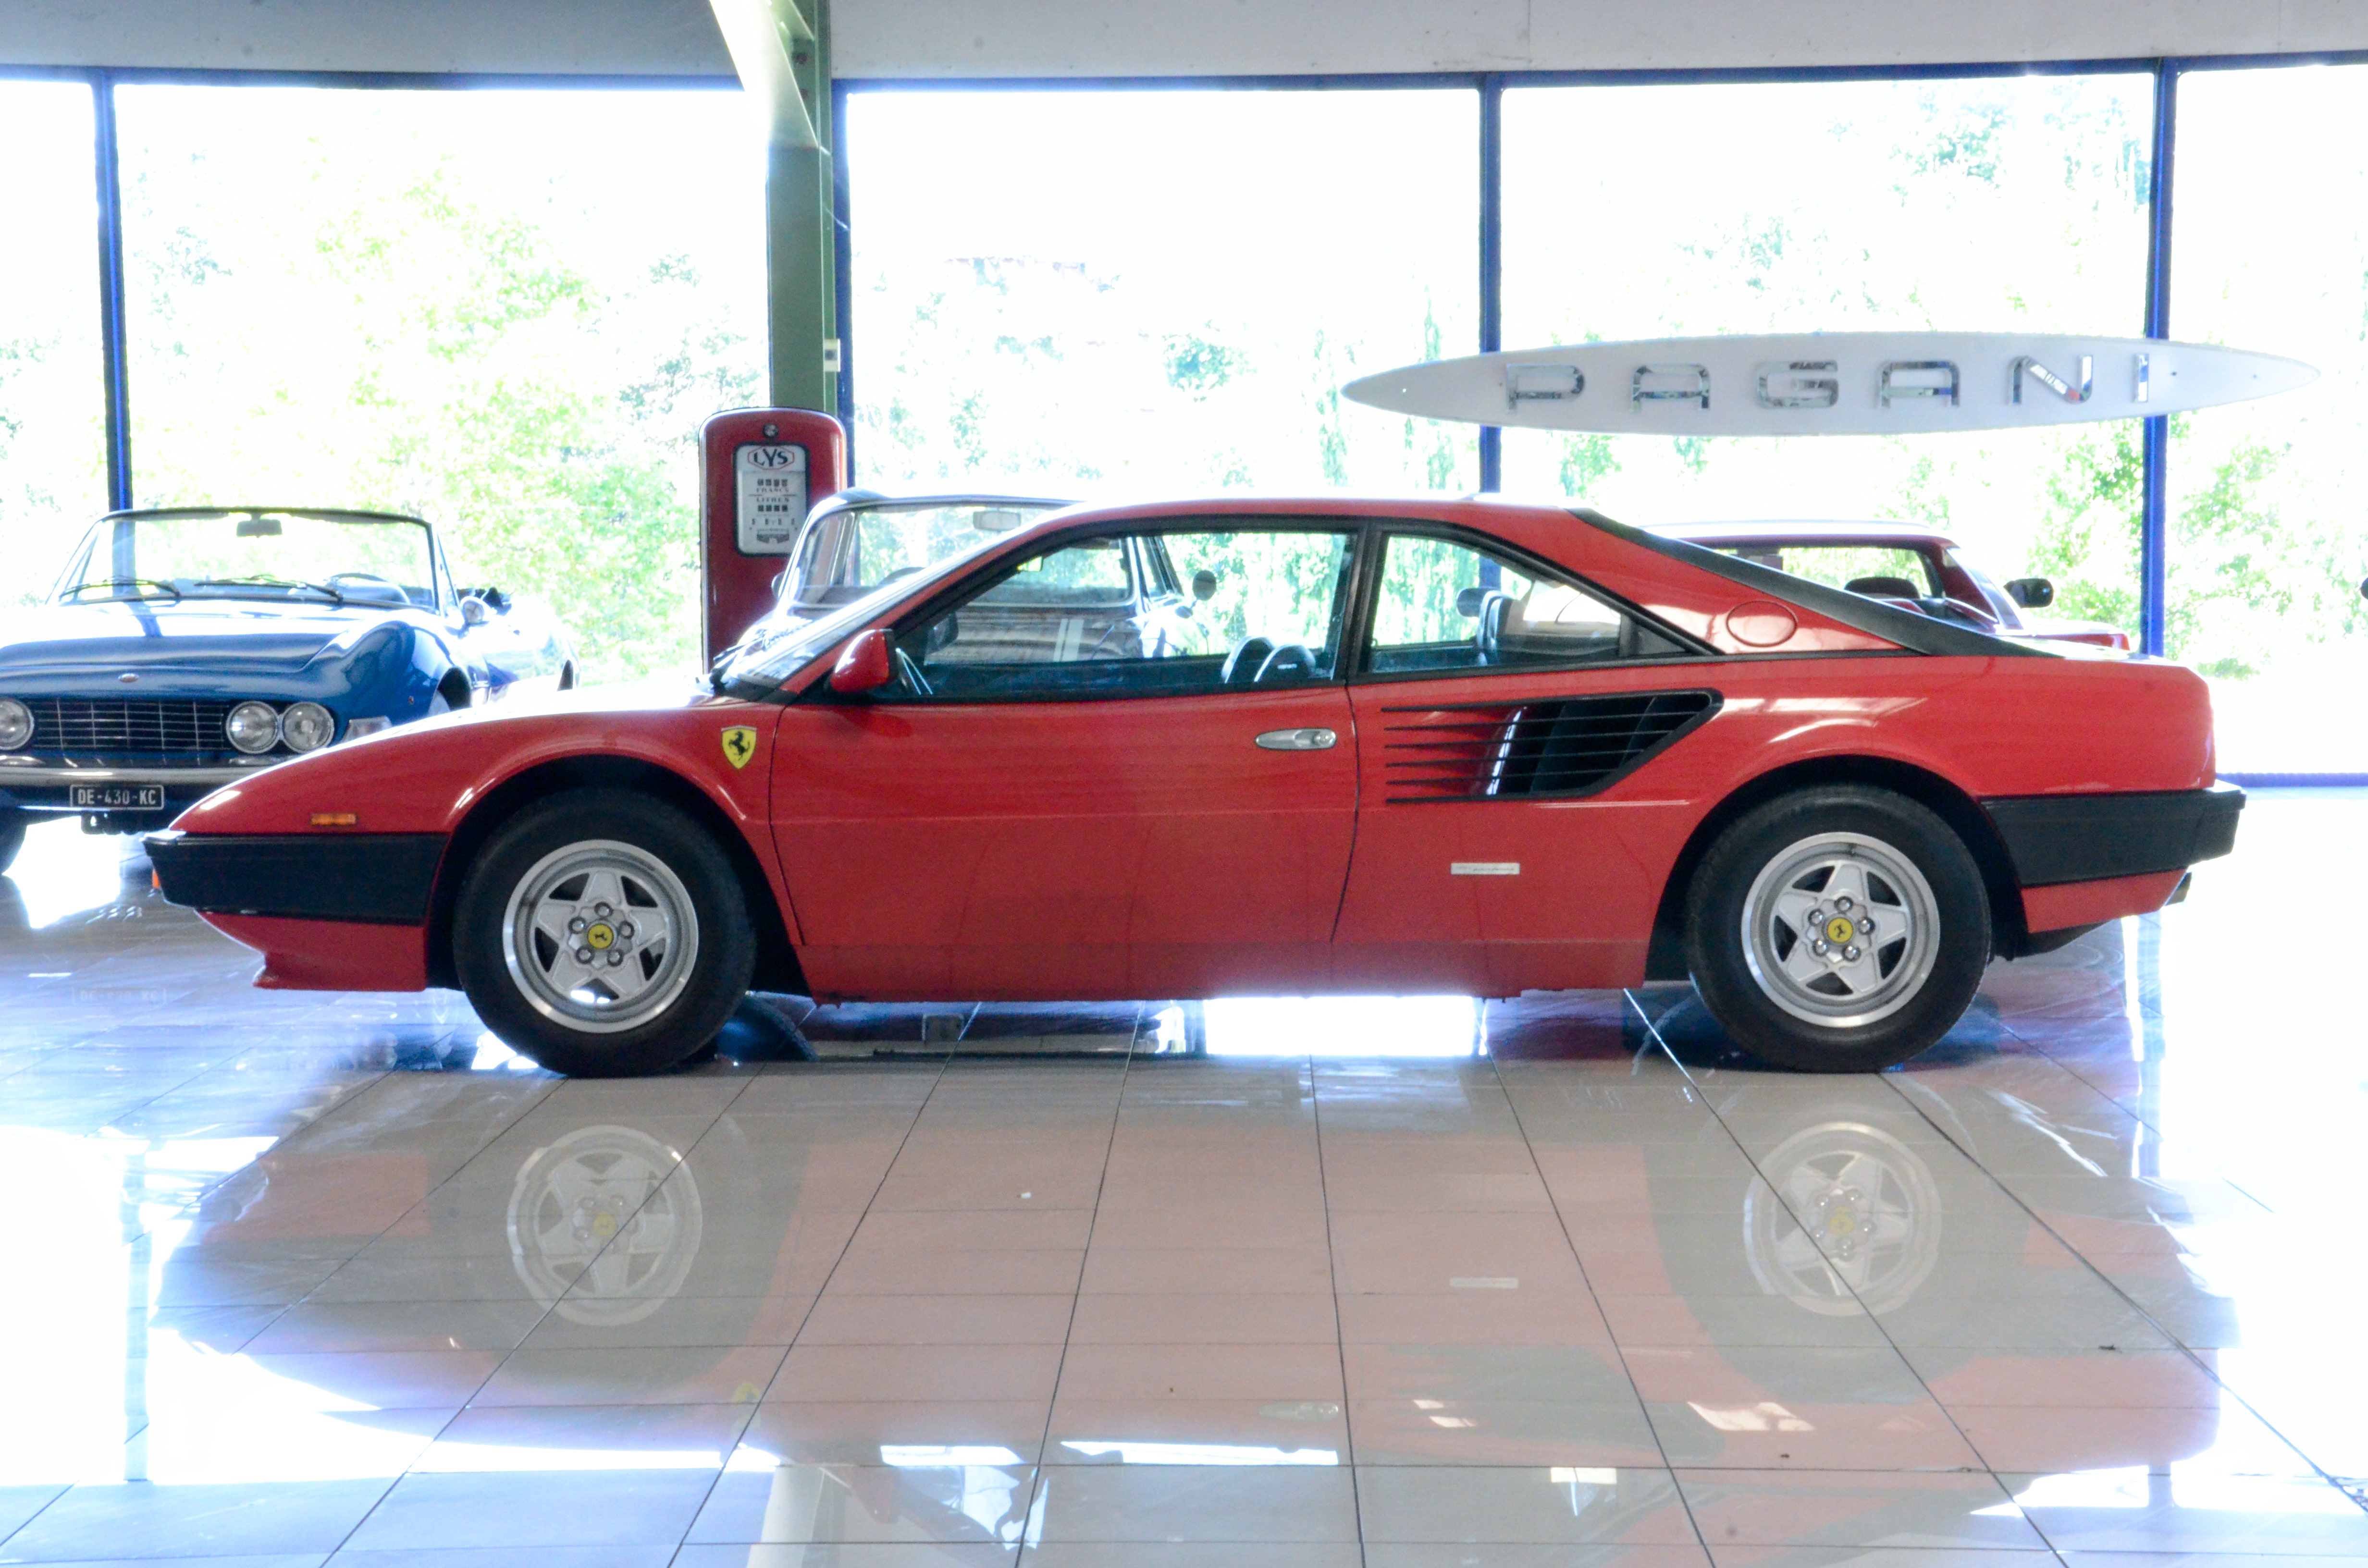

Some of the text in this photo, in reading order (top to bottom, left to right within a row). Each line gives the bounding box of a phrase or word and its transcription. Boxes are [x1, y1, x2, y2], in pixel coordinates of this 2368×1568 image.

[1506, 354, 2149, 411] PAGANI
[753, 449, 788, 467] LYS
[78, 789, 156, 805] DE-430-KC
